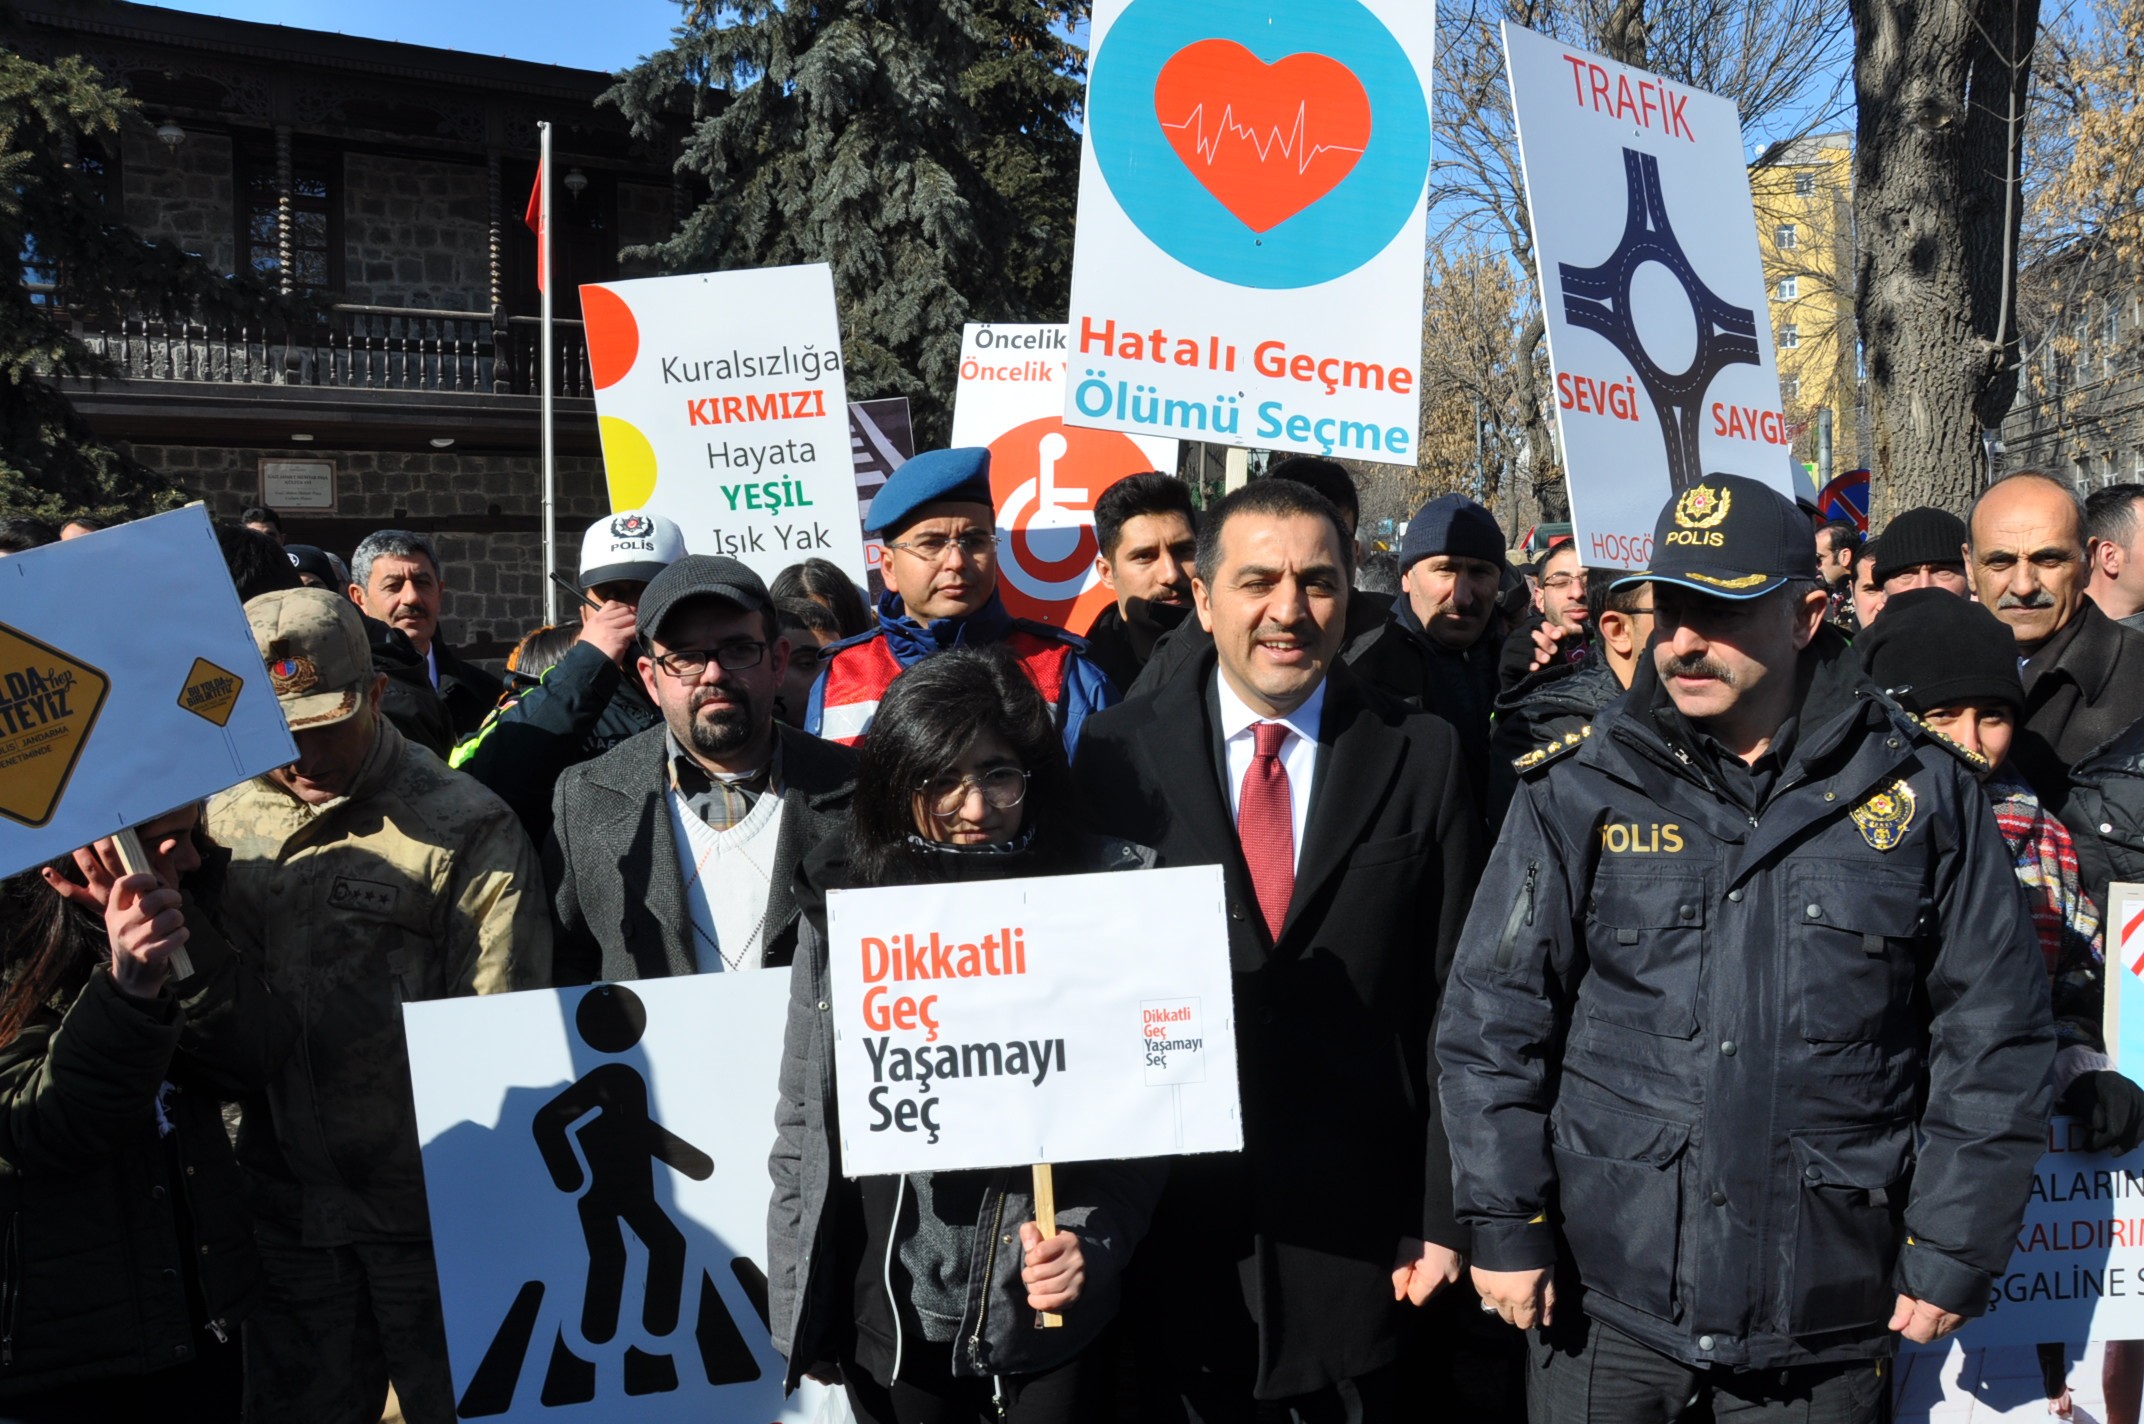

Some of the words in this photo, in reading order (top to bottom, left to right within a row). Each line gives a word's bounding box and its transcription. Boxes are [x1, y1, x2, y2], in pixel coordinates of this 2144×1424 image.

[1563, 54, 1695, 143] TRAFİK
[975, 324, 1067, 350] Öncelik
[1079, 316, 1236, 373] Hatalı
[1254, 341, 1413, 395] Geçme
[661, 344, 840, 384] Kuralsızlığa
[960, 356, 1052, 381] Öncelik
[687, 390, 826, 426] KIRMIZI
[1075, 369, 1239, 434] Ölümü
[1257, 401, 1409, 456] Seçme
[1557, 372, 1639, 422] SEVGİ
[1712, 402, 1787, 445] SAYGI
[707, 439, 816, 475] Hayata
[720, 474, 813, 516] YEŞİL
[611, 540, 654, 552] POLİS
[713, 526, 766, 560] Işık
[774, 522, 832, 551] Yak
[1602, 823, 1684, 853] OLİS
[861, 927, 1026, 983] Dikkatli
[862, 986, 939, 1042] Geç
[1143, 1006, 1191, 1024] Dikkatli
[1144, 1024, 1167, 1041] Geç
[862, 1036, 1066, 1093] Yaşamayı
[1144, 1038, 1203, 1055] Yaşamayı
[1146, 1052, 1167, 1070] Seç
[868, 1086, 941, 1145] Seç
